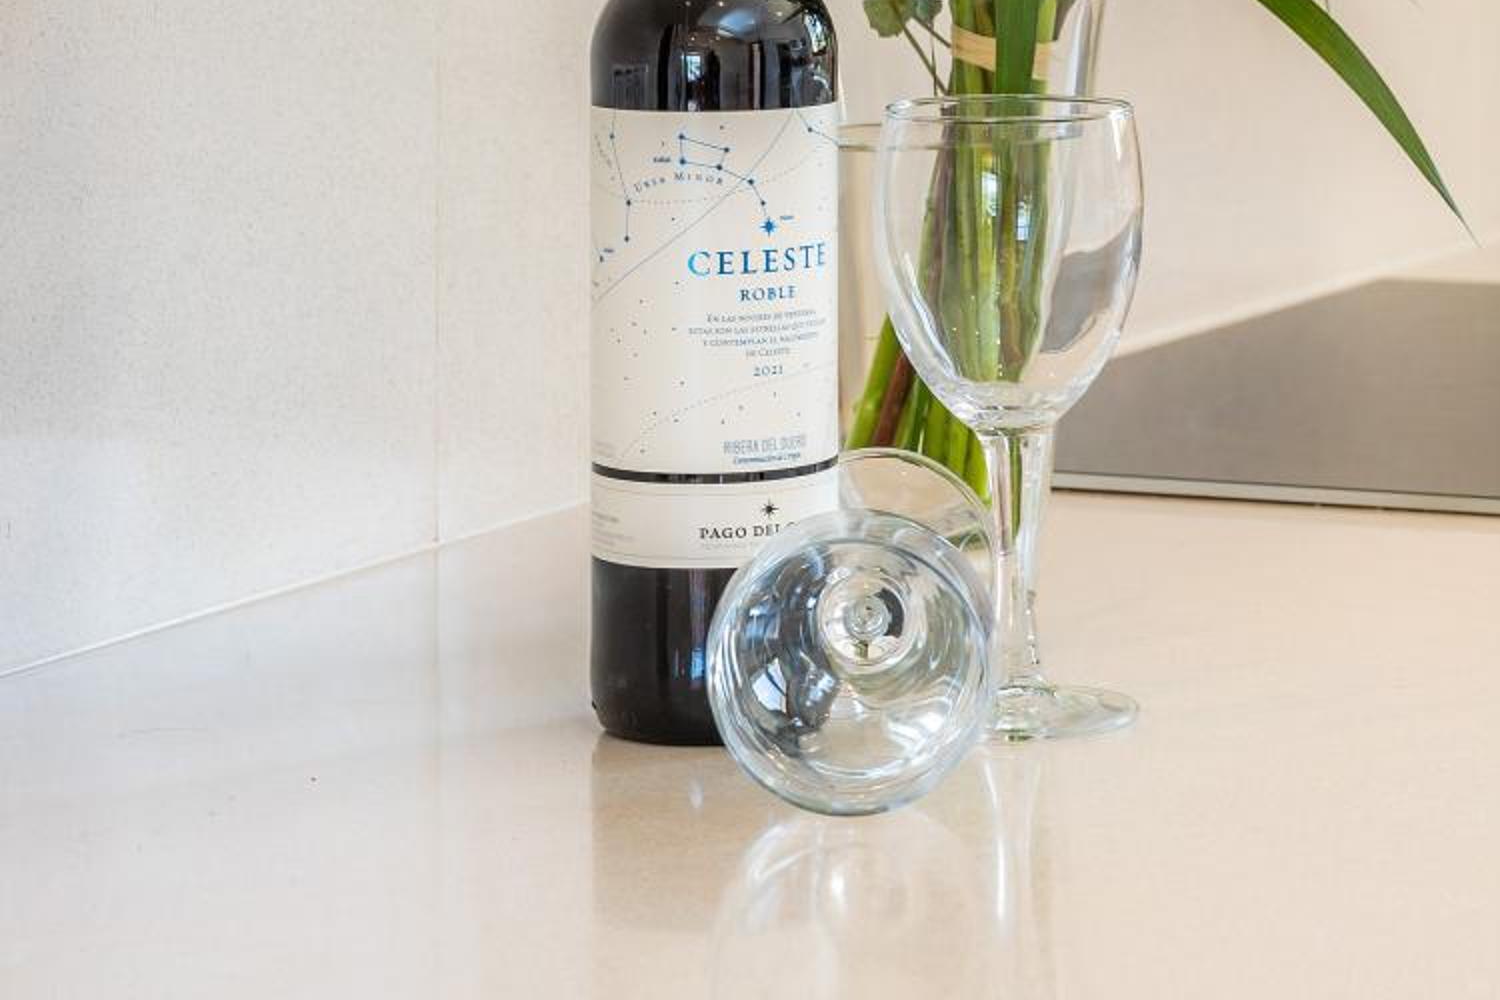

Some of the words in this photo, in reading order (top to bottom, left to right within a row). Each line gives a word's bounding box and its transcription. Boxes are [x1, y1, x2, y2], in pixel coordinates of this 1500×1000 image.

[687, 242, 826, 276] CELESTE
[740, 285, 797, 302] ROBLE
[753, 364, 784, 378] 2021
[698, 526, 748, 540] PAGO
